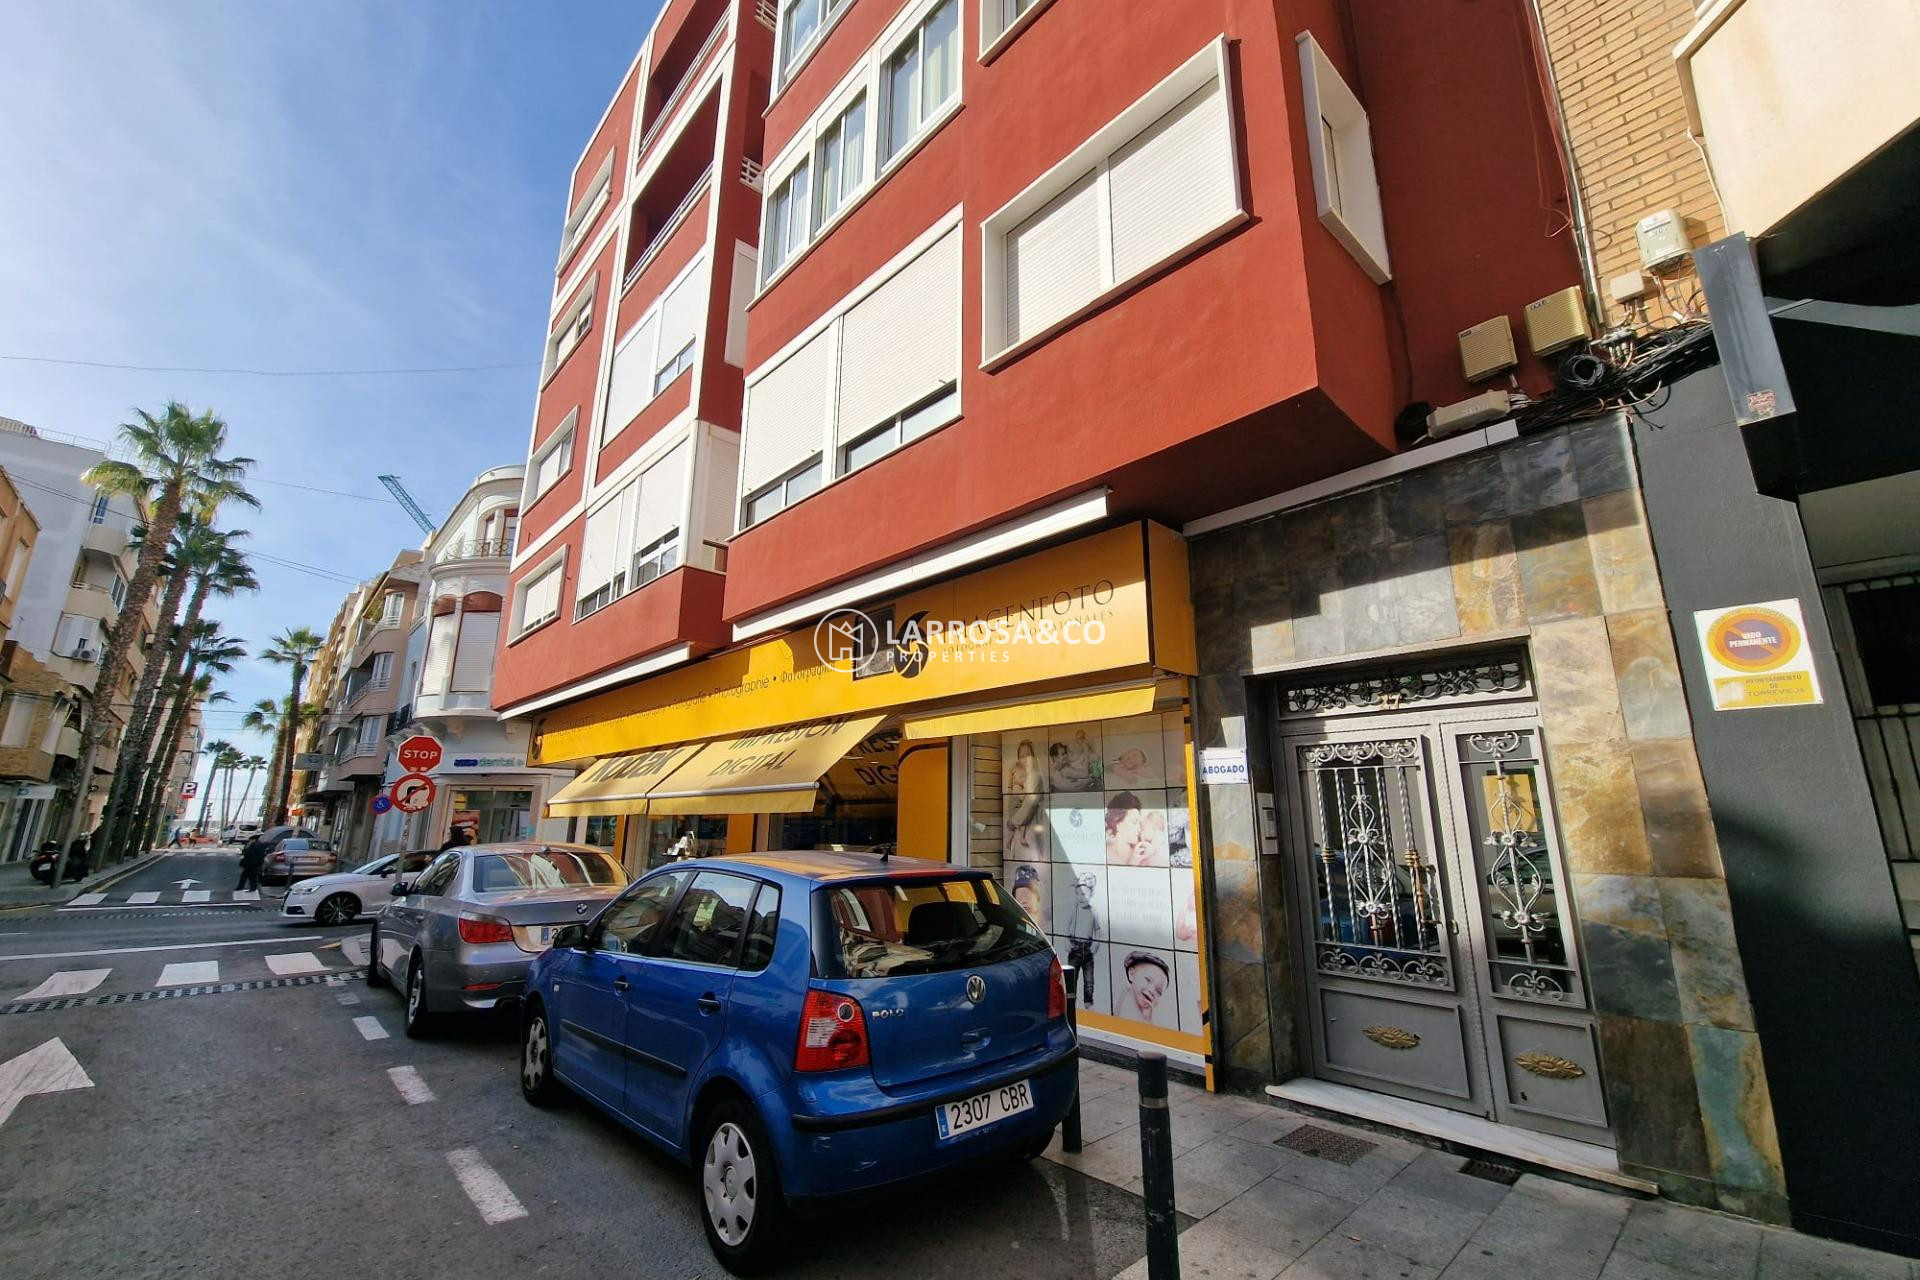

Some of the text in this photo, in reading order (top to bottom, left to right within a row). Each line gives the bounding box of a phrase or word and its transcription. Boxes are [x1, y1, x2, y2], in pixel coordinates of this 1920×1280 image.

[402, 749, 438, 759] STOP
[707, 749, 798, 777] DIGITAL
[1202, 765, 1245, 775] ABOGADO
[871, 1008, 905, 1020] POLO
[950, 1094, 991, 1130] 2307
[1000, 1083, 1029, 1112] CBR
